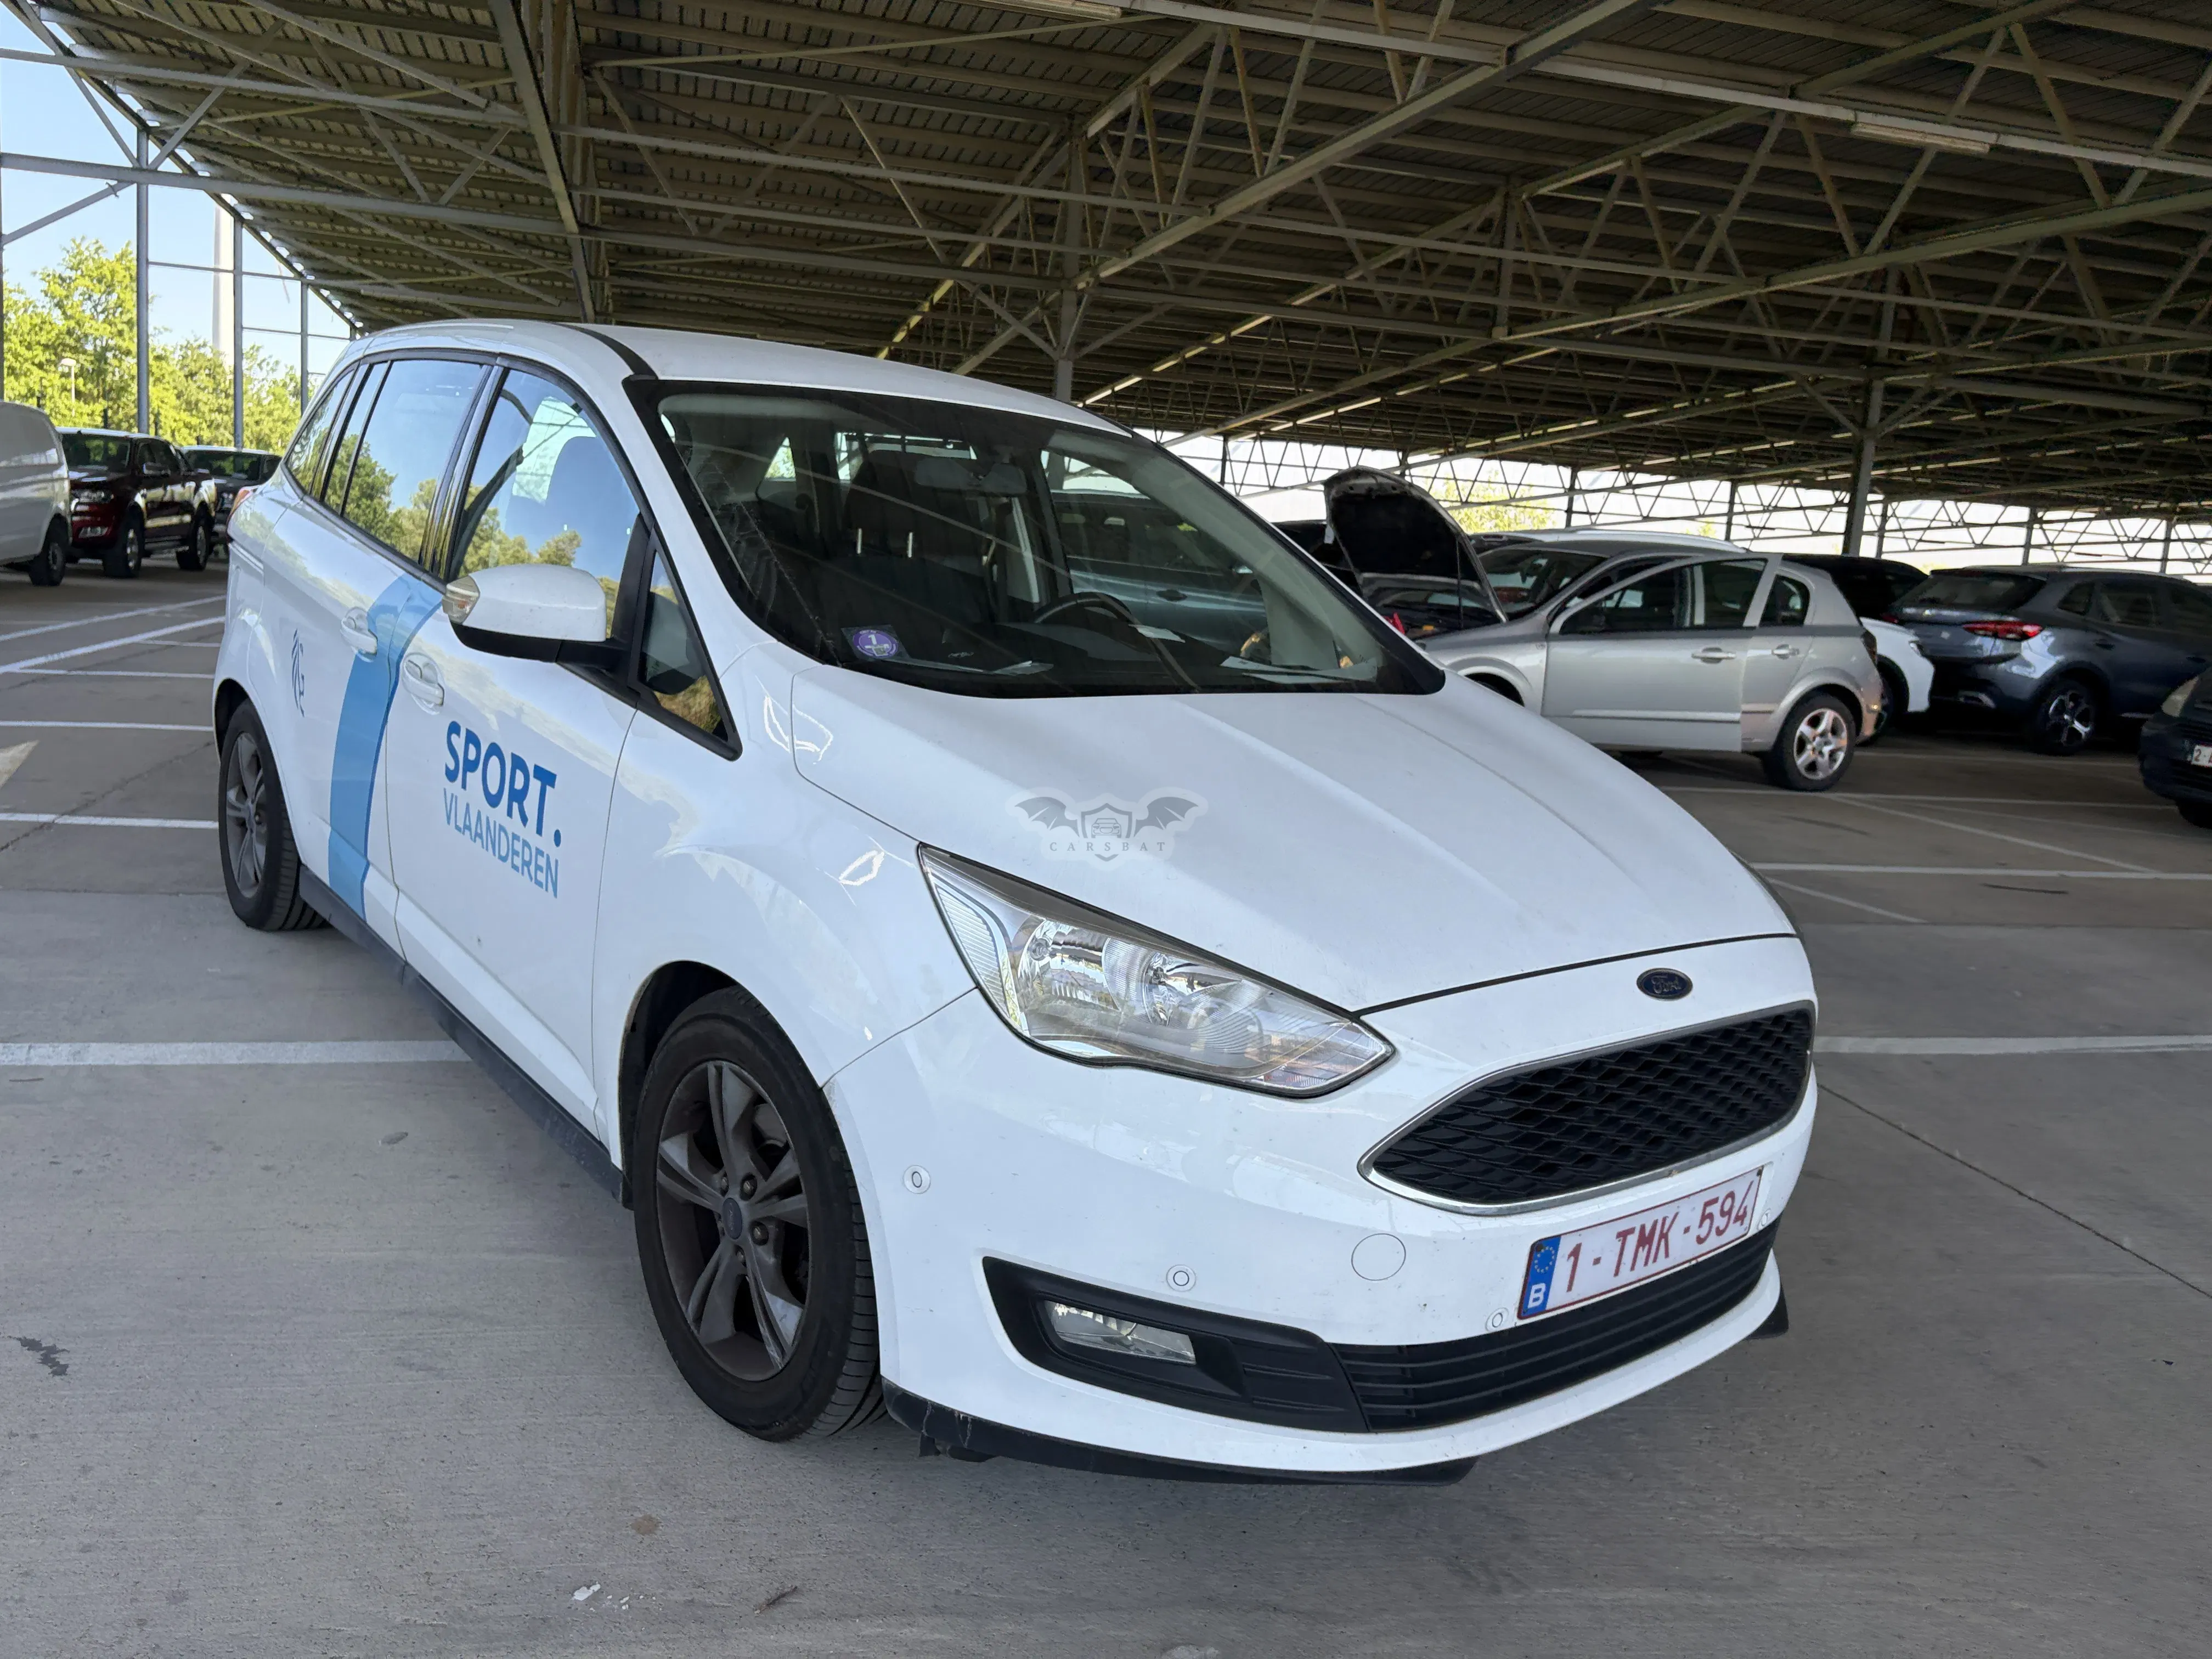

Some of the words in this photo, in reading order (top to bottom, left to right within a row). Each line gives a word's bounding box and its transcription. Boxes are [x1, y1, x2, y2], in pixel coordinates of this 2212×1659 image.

[868, 634, 877, 645] 1
[445, 721, 561, 847] SPORT.
[443, 787, 558, 899] VLAANDEREN
[1651, 975, 1682, 994] Ford
[1527, 1283, 1546, 1309] B
